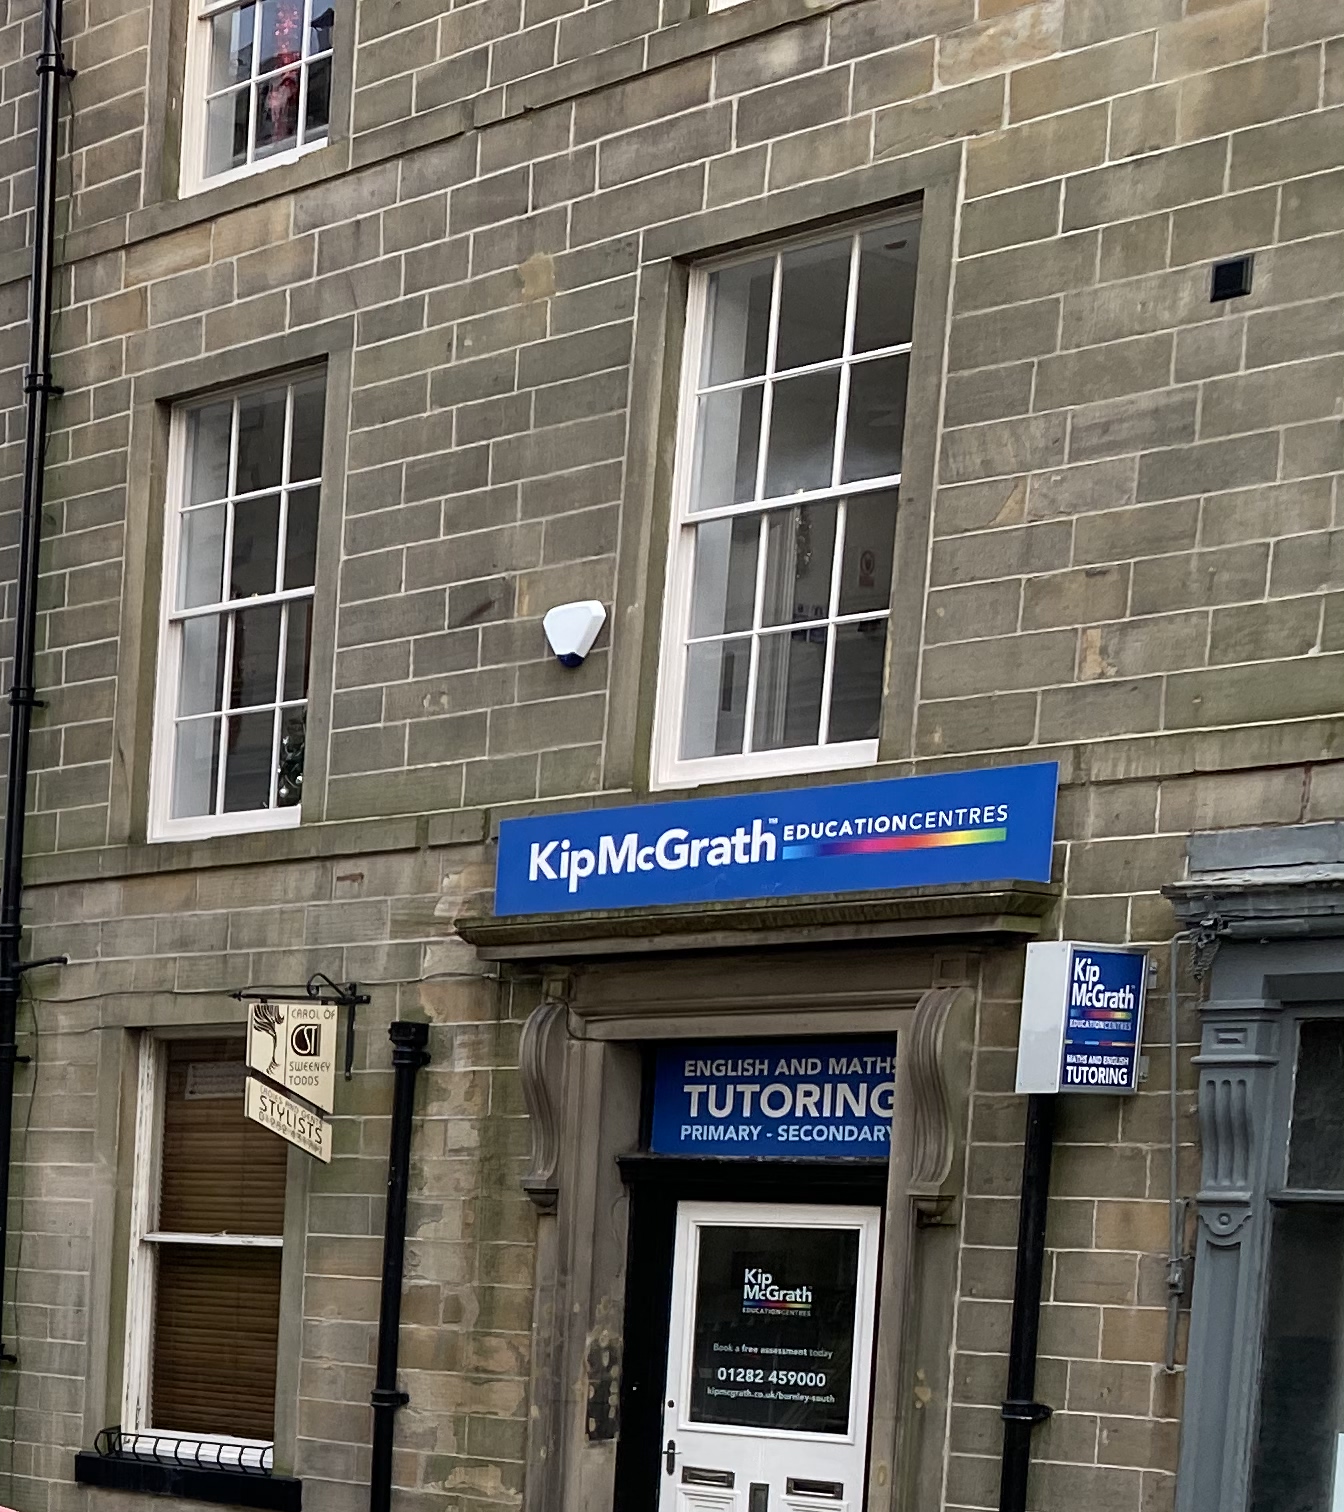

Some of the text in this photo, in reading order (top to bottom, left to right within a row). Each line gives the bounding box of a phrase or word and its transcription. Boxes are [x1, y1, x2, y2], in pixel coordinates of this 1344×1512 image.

[1073, 957, 1100, 991] Kip
[1071, 983, 1134, 1010] McGrath
[291, 1007, 336, 1020] CAROL OF
[288, 1060, 331, 1073] SWEENEY
[684, 1059, 769, 1077] ENGLISH
[774, 1057, 822, 1077] AND
[1066, 1053, 1130, 1066] MATHS AND ENGLISH
[288, 1075, 320, 1086] TODDS
[1065, 1065, 1129, 1086] TUTORING
[683, 1081, 896, 1118] TUTORING
[258, 1094, 323, 1145] STYLISTS
[680, 1124, 762, 1141] PRIMARY
[744, 1268, 773, 1290] Kip
[743, 1285, 812, 1303] McGrath
[713, 1343, 733, 1352] Book
[741, 1344, 759, 1354] free
[809, 1348, 834, 1360] today
[717, 1367, 827, 1387] 01282 459000
